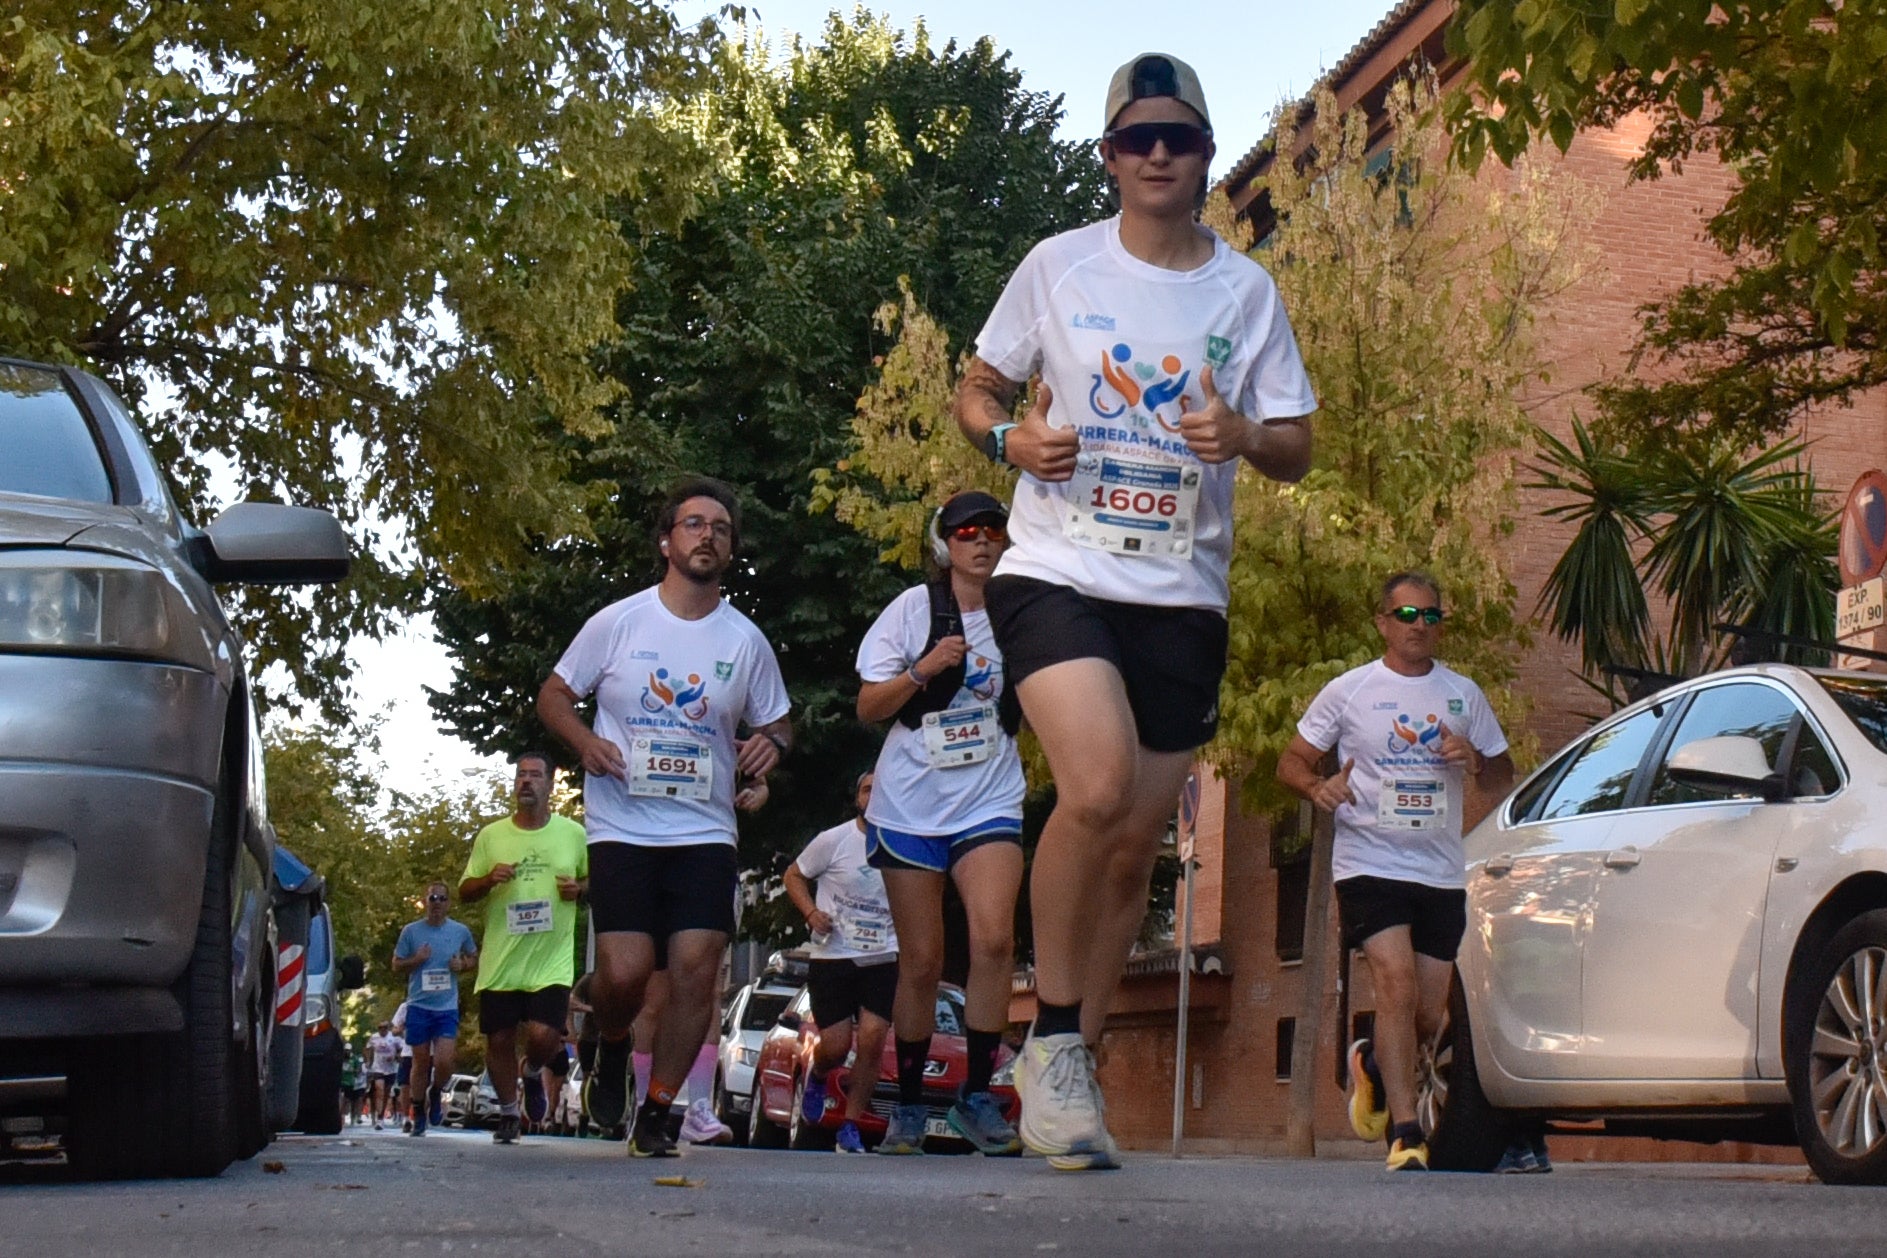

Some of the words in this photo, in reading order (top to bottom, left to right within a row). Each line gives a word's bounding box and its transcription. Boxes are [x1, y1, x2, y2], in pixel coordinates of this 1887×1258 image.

[1090, 485, 1177, 516] 1606
[944, 724, 981, 742] 544
[647, 757, 698, 774] 1691
[1397, 795, 1432, 807] 553
